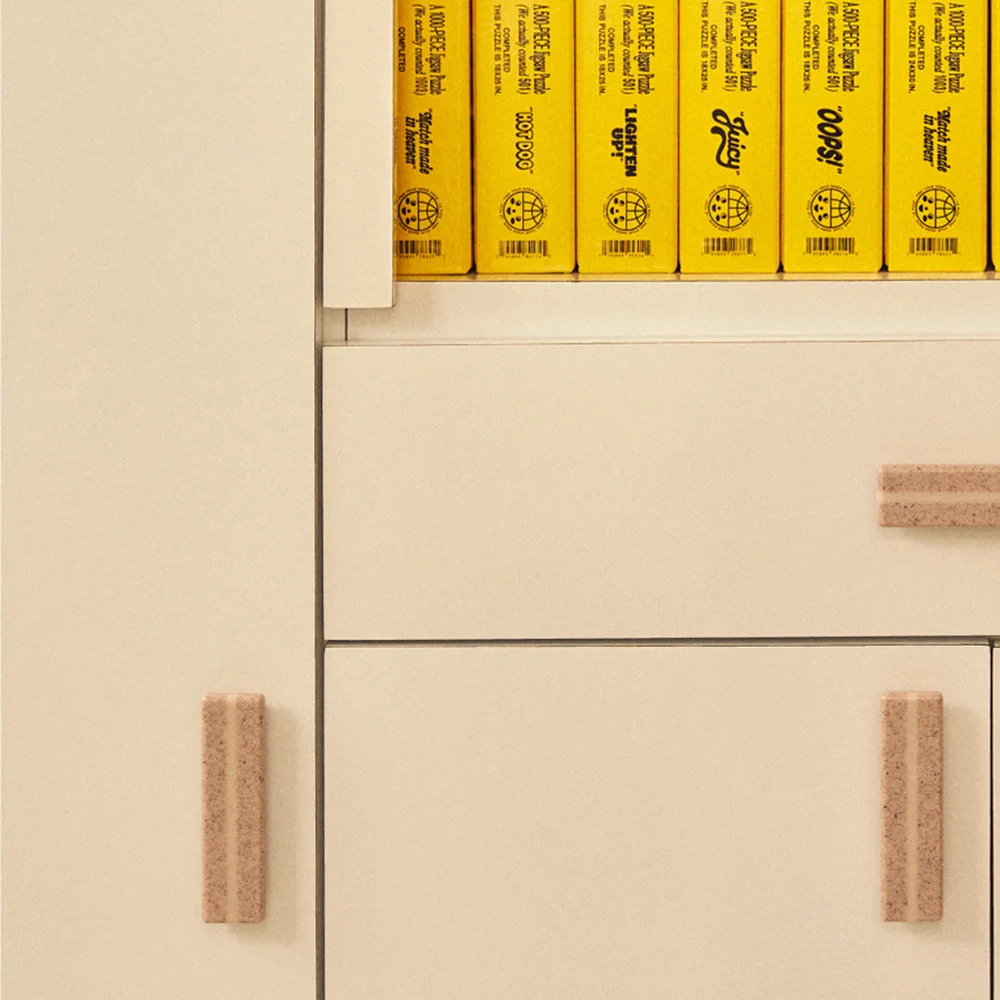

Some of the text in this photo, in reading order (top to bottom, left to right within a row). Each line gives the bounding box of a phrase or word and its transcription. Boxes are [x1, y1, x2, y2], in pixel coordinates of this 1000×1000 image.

[398, 27, 406, 72] COMPLETED
[429, 12, 446, 52] 1000-PIECE
[812, 25, 820, 70] COMPLETED
[426, 53, 446, 73] Jigsaw
[430, 75, 446, 95] Puzzle
